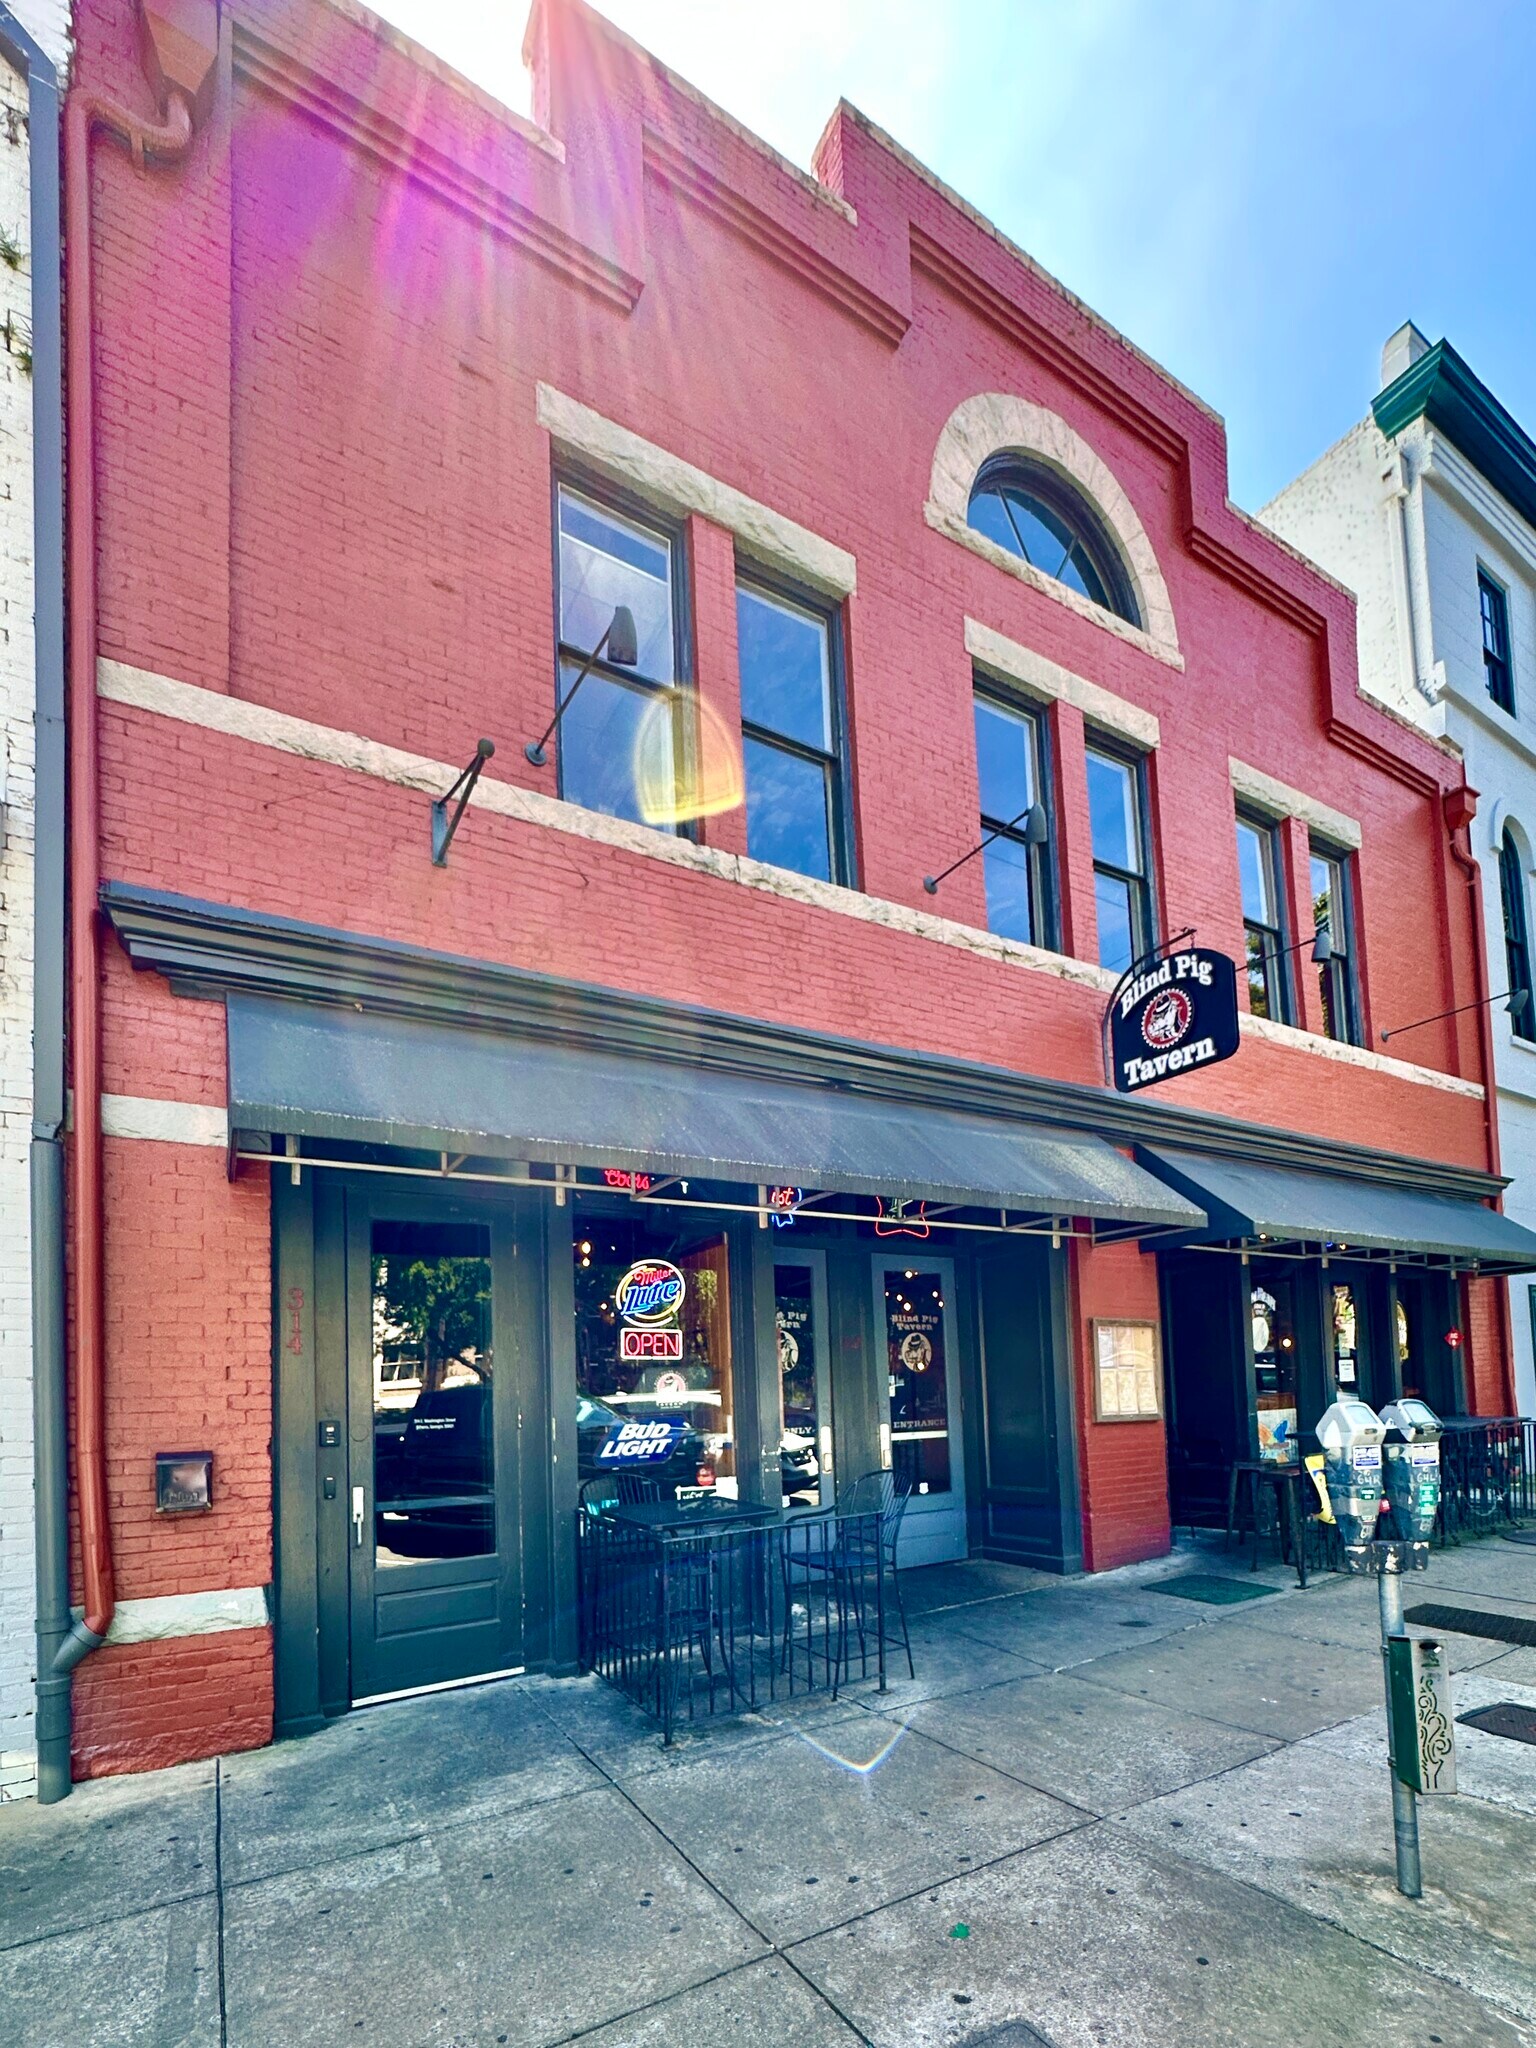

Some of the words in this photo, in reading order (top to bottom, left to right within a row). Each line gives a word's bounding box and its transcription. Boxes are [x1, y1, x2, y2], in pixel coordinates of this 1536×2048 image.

[1120, 959, 1171, 1019] Blind
[1175, 954, 1214, 986] Pig
[1123, 1037, 1216, 1086] Tavern
[633, 1269, 675, 1286] Miller
[620, 1280, 681, 1316] Lite
[286, 1287, 305, 1356] 314
[787, 1311, 808, 1322] Pig
[891, 1314, 919, 1324] Blind
[922, 1314, 939, 1324] Pig
[896, 1323, 933, 1331] Tavern
[625, 1332, 679, 1356] OPEN
[617, 1422, 672, 1441] BUD
[893, 1418, 946, 1429] ENTRANCE
[600, 1438, 673, 1458] LIGHT
